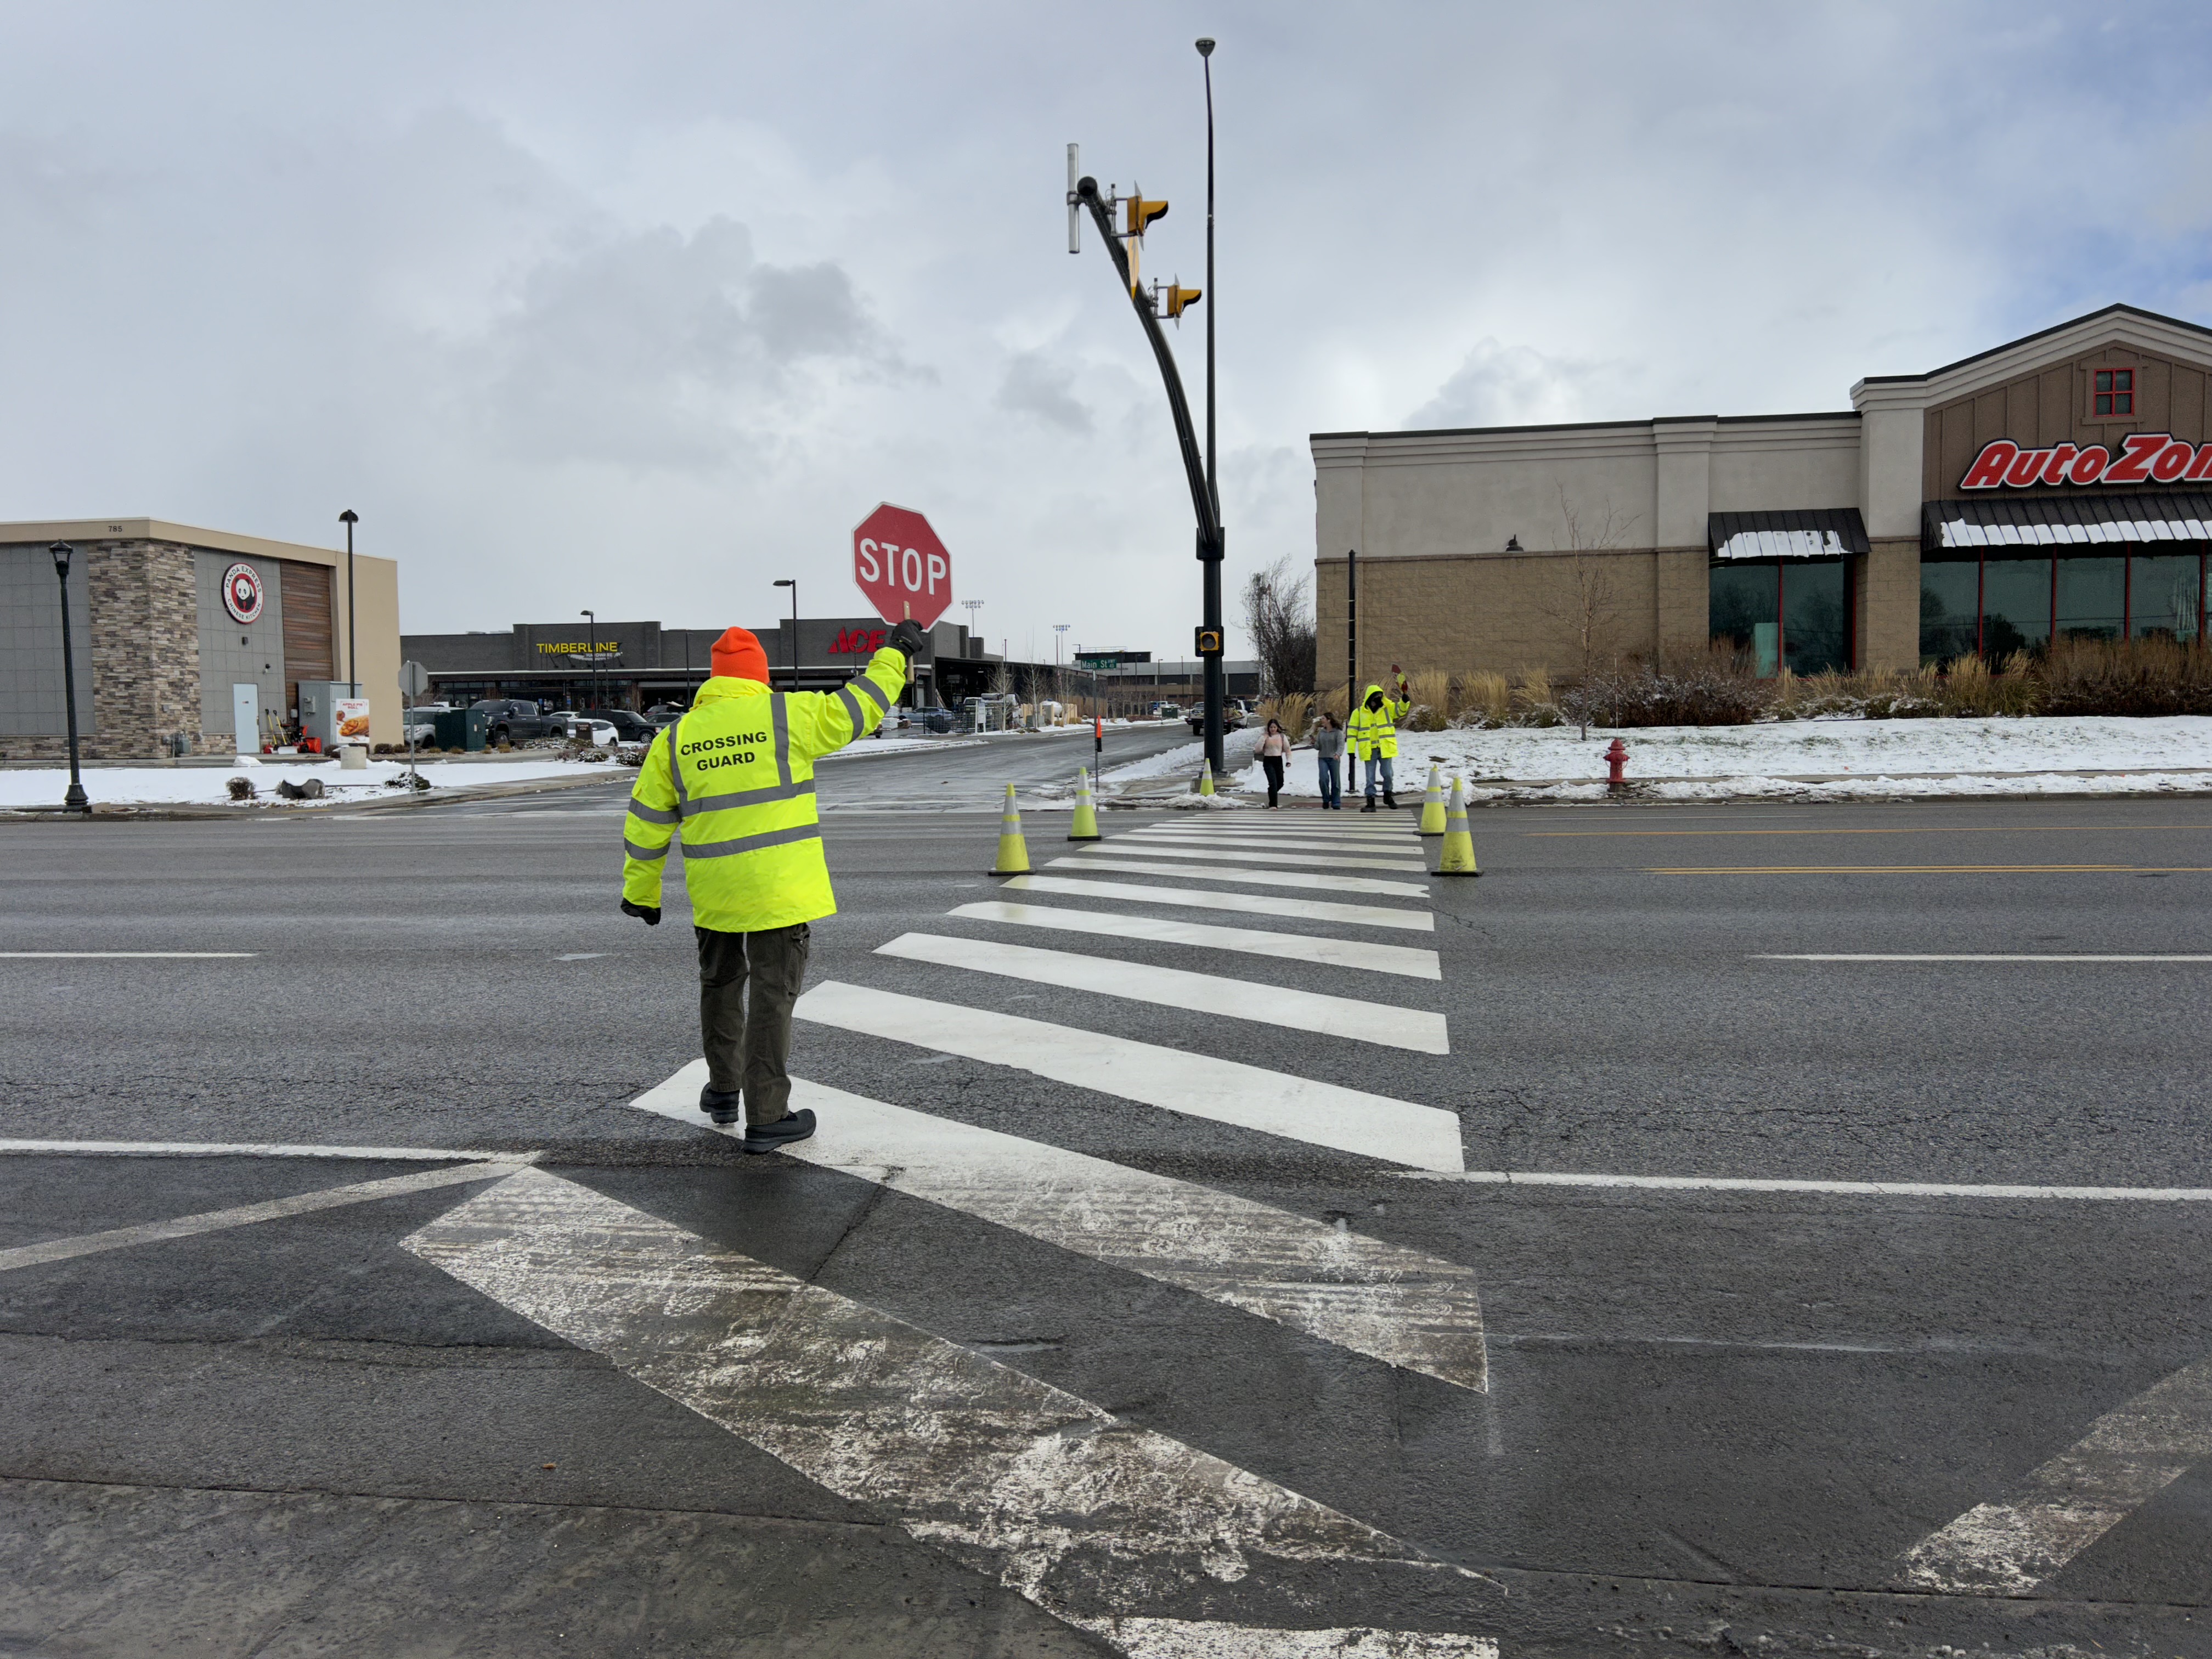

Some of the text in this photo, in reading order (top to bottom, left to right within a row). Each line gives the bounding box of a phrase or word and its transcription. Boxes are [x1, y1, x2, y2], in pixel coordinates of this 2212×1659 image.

[1960, 435, 2212, 488] AutoZon
[860, 538, 946, 595] STOP
[225, 566, 262, 592] PANDA EXPRESS
[228, 599, 261, 620] CHINESE KITCHEN
[536, 642, 618, 653] TIMBERLINE
[827, 627, 887, 653] ACE
[1082, 661, 1097, 669] Main
[1100, 660, 1107, 668] St
[680, 732, 767, 755] CROSSING
[697, 752, 755, 771] GUARD
